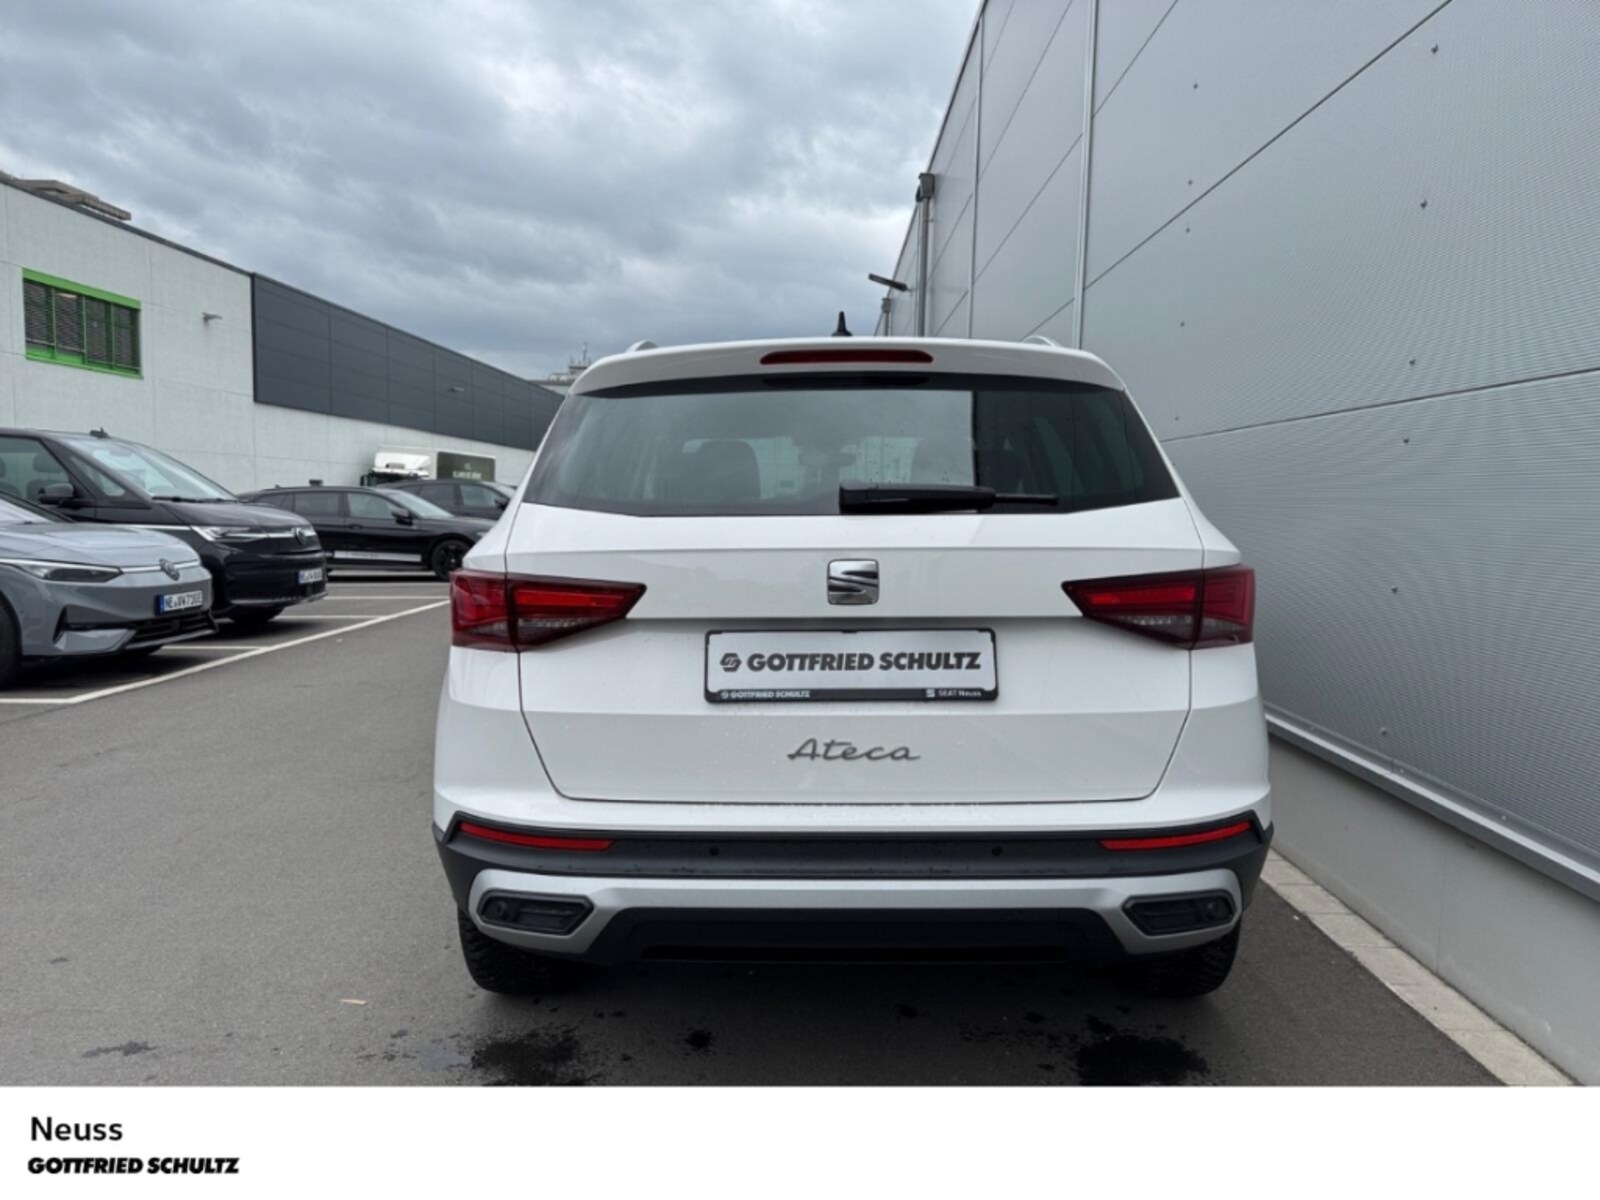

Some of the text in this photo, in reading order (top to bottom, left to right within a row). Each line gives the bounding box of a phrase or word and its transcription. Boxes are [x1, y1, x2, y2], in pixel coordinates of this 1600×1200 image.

[747, 652, 982, 672] GOTTFRIED SCHULTZ
[730, 690, 811, 699] GOTTFRIED SCHULTZ
[938, 689, 982, 697] SEAT Neuss
[786, 737, 922, 761] Ateca
